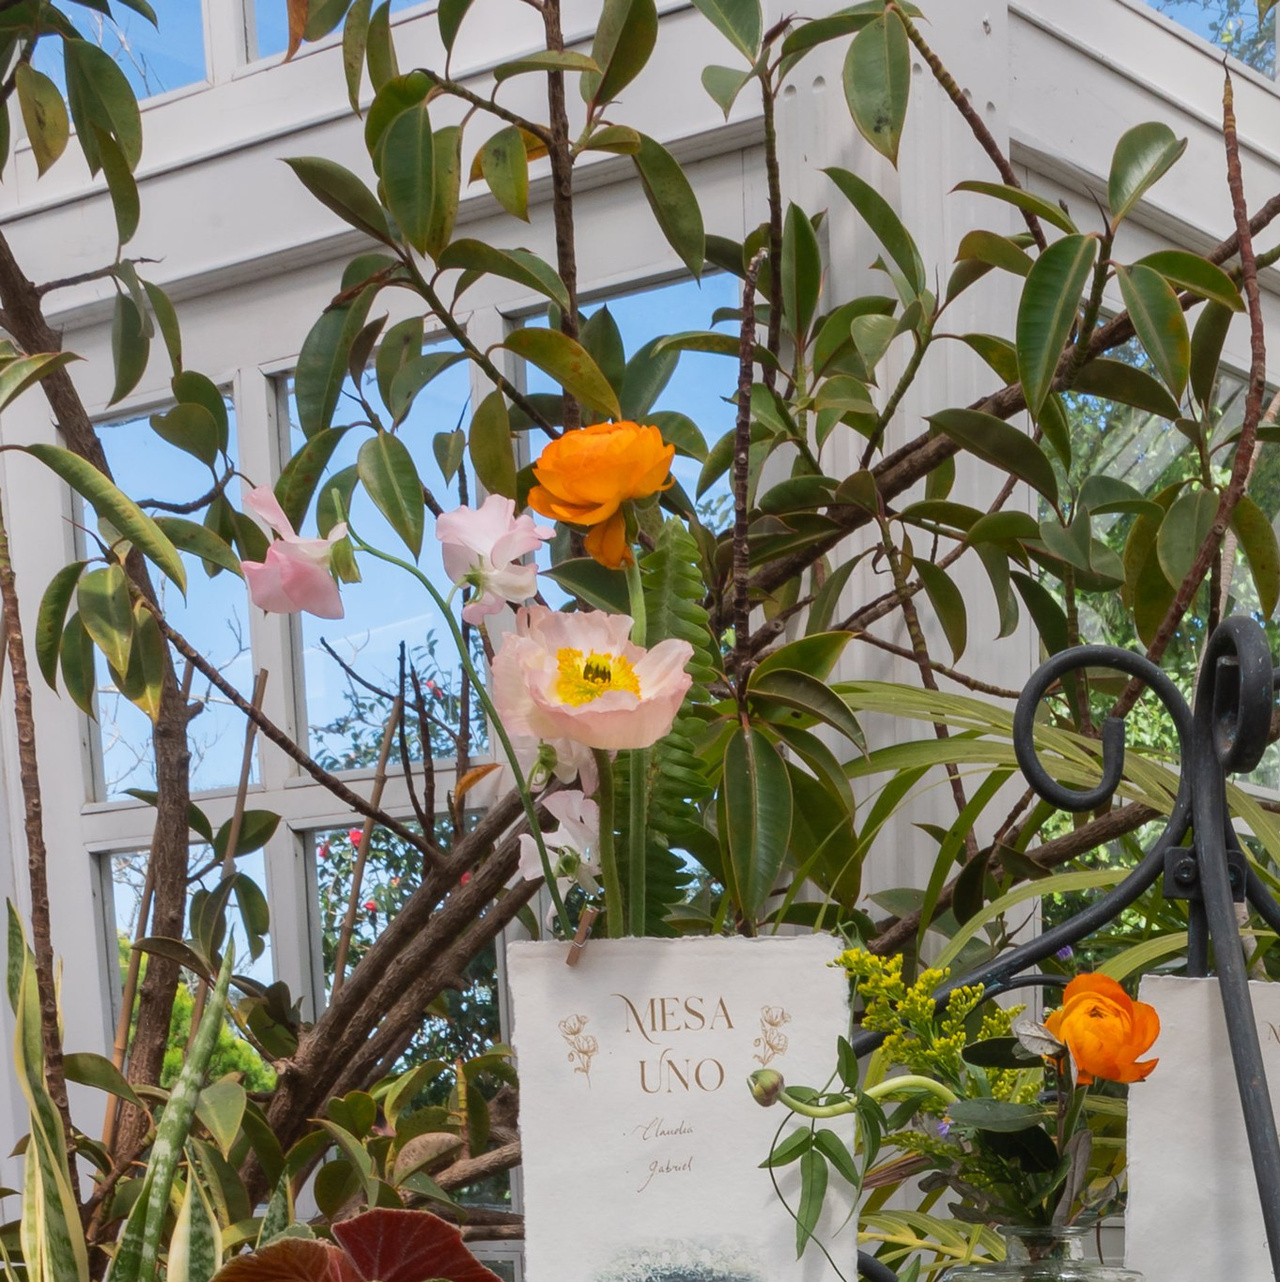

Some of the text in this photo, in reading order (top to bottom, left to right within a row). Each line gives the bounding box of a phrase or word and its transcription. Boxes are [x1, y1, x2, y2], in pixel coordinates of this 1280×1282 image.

[610, 993, 735, 1045] MESA
[638, 1048, 726, 1094] UNO
[637, 1156, 693, 1193] Gabriel
